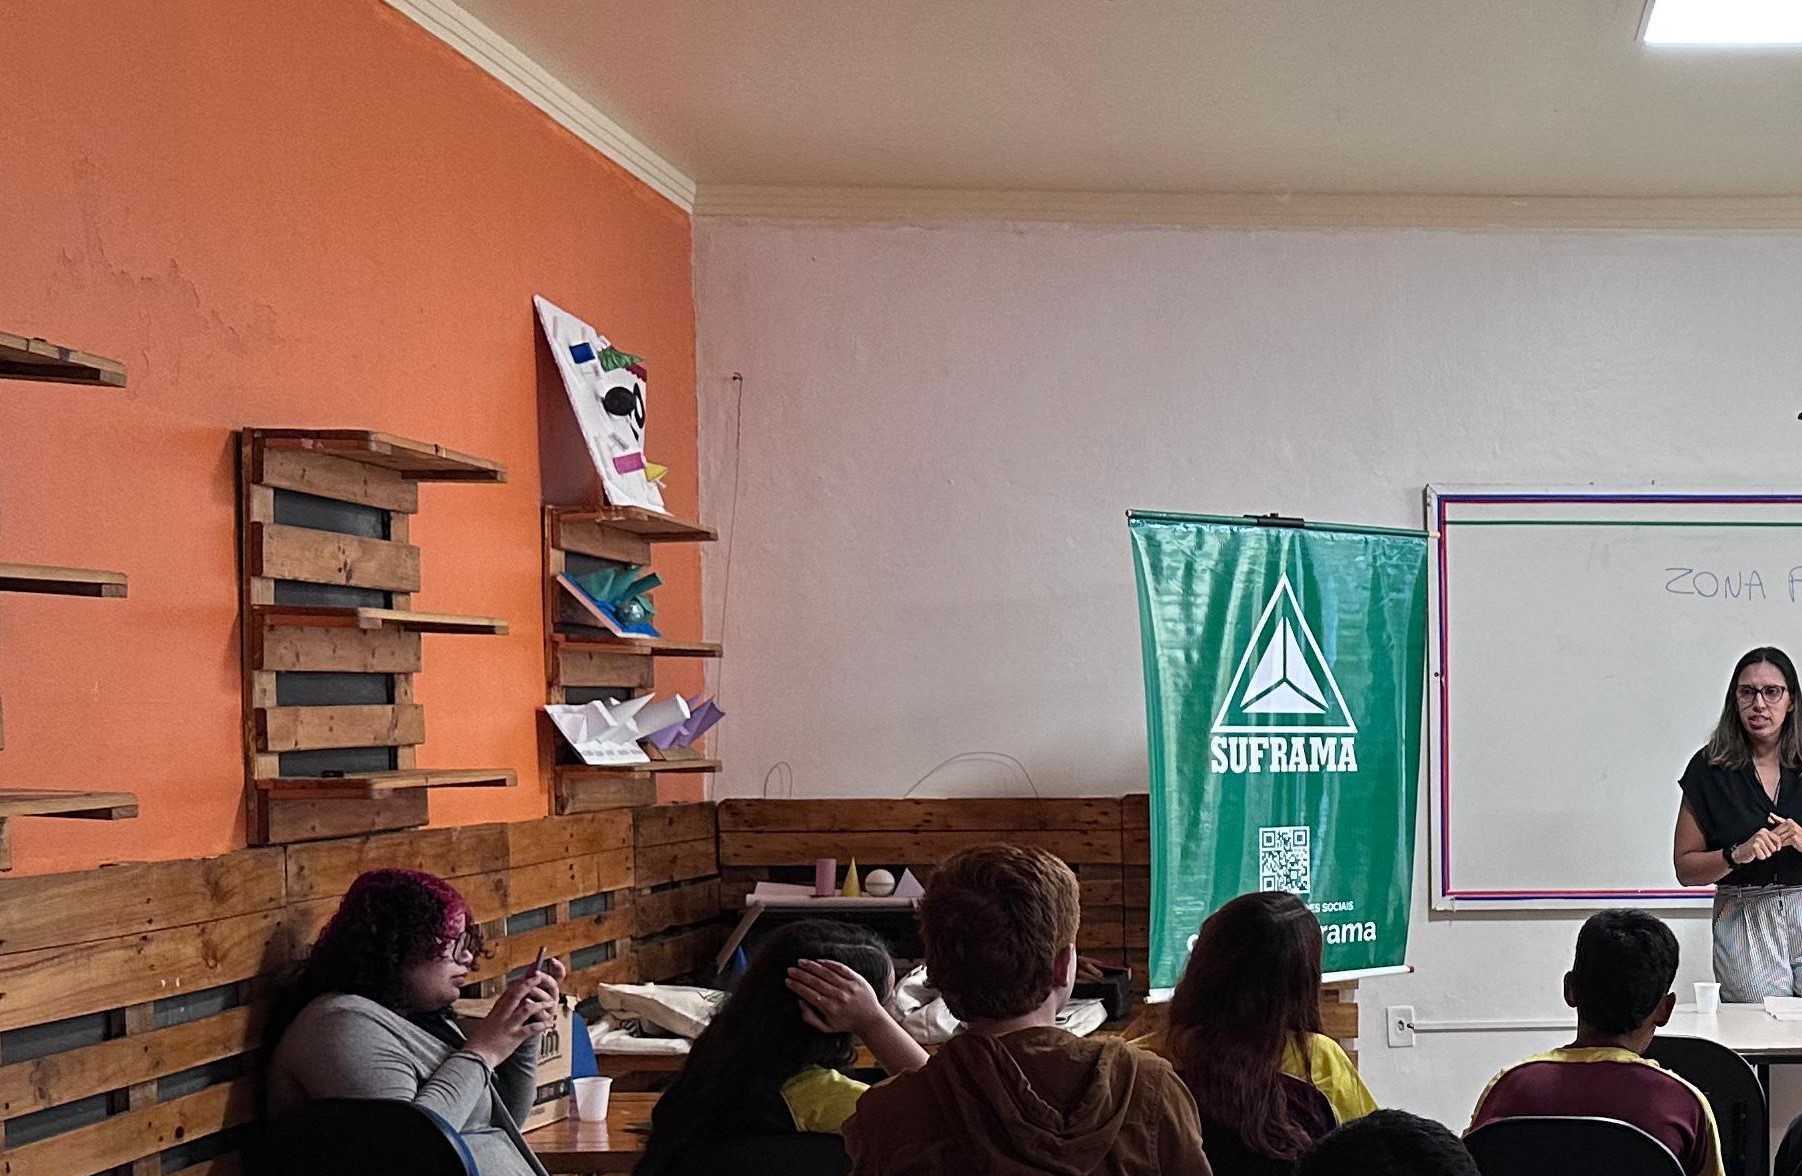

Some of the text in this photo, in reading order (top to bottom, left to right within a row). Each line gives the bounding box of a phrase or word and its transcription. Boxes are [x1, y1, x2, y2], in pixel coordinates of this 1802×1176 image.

[1665, 567, 1766, 600] ZONA
[1210, 736, 1358, 774] SUFRAMA
[1321, 900, 1354, 913] SOCIAIS
